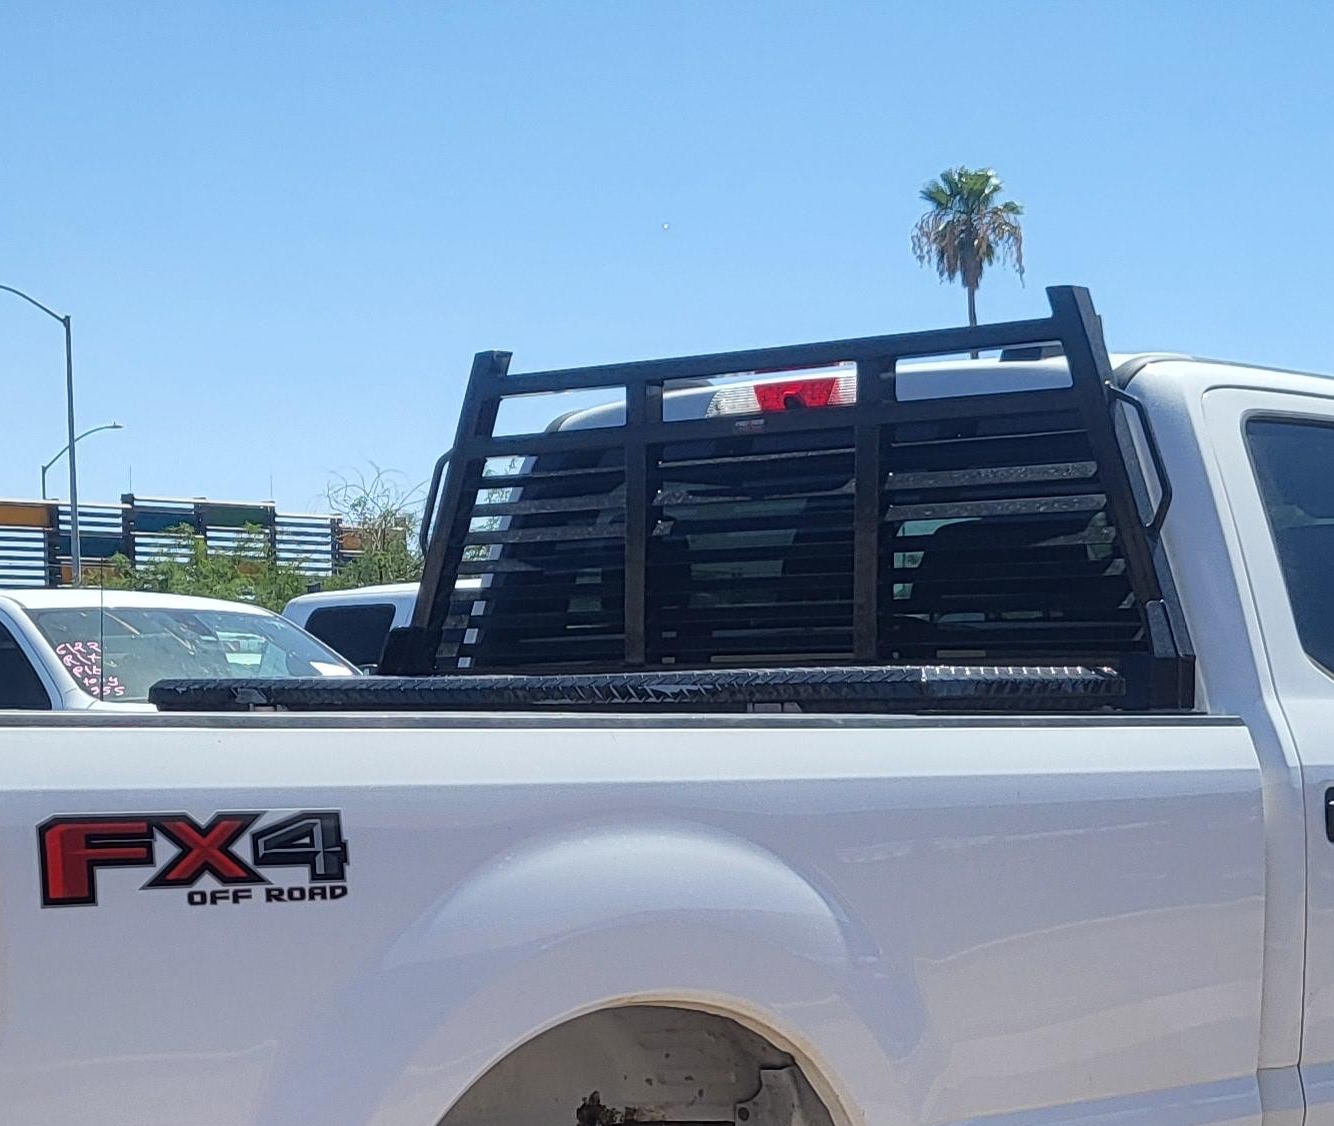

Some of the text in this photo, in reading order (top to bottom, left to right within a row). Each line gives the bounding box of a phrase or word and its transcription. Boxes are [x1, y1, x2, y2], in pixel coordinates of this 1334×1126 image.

[36, 808, 350, 908] FX4
[187, 885, 349, 906] OFF ROAD
